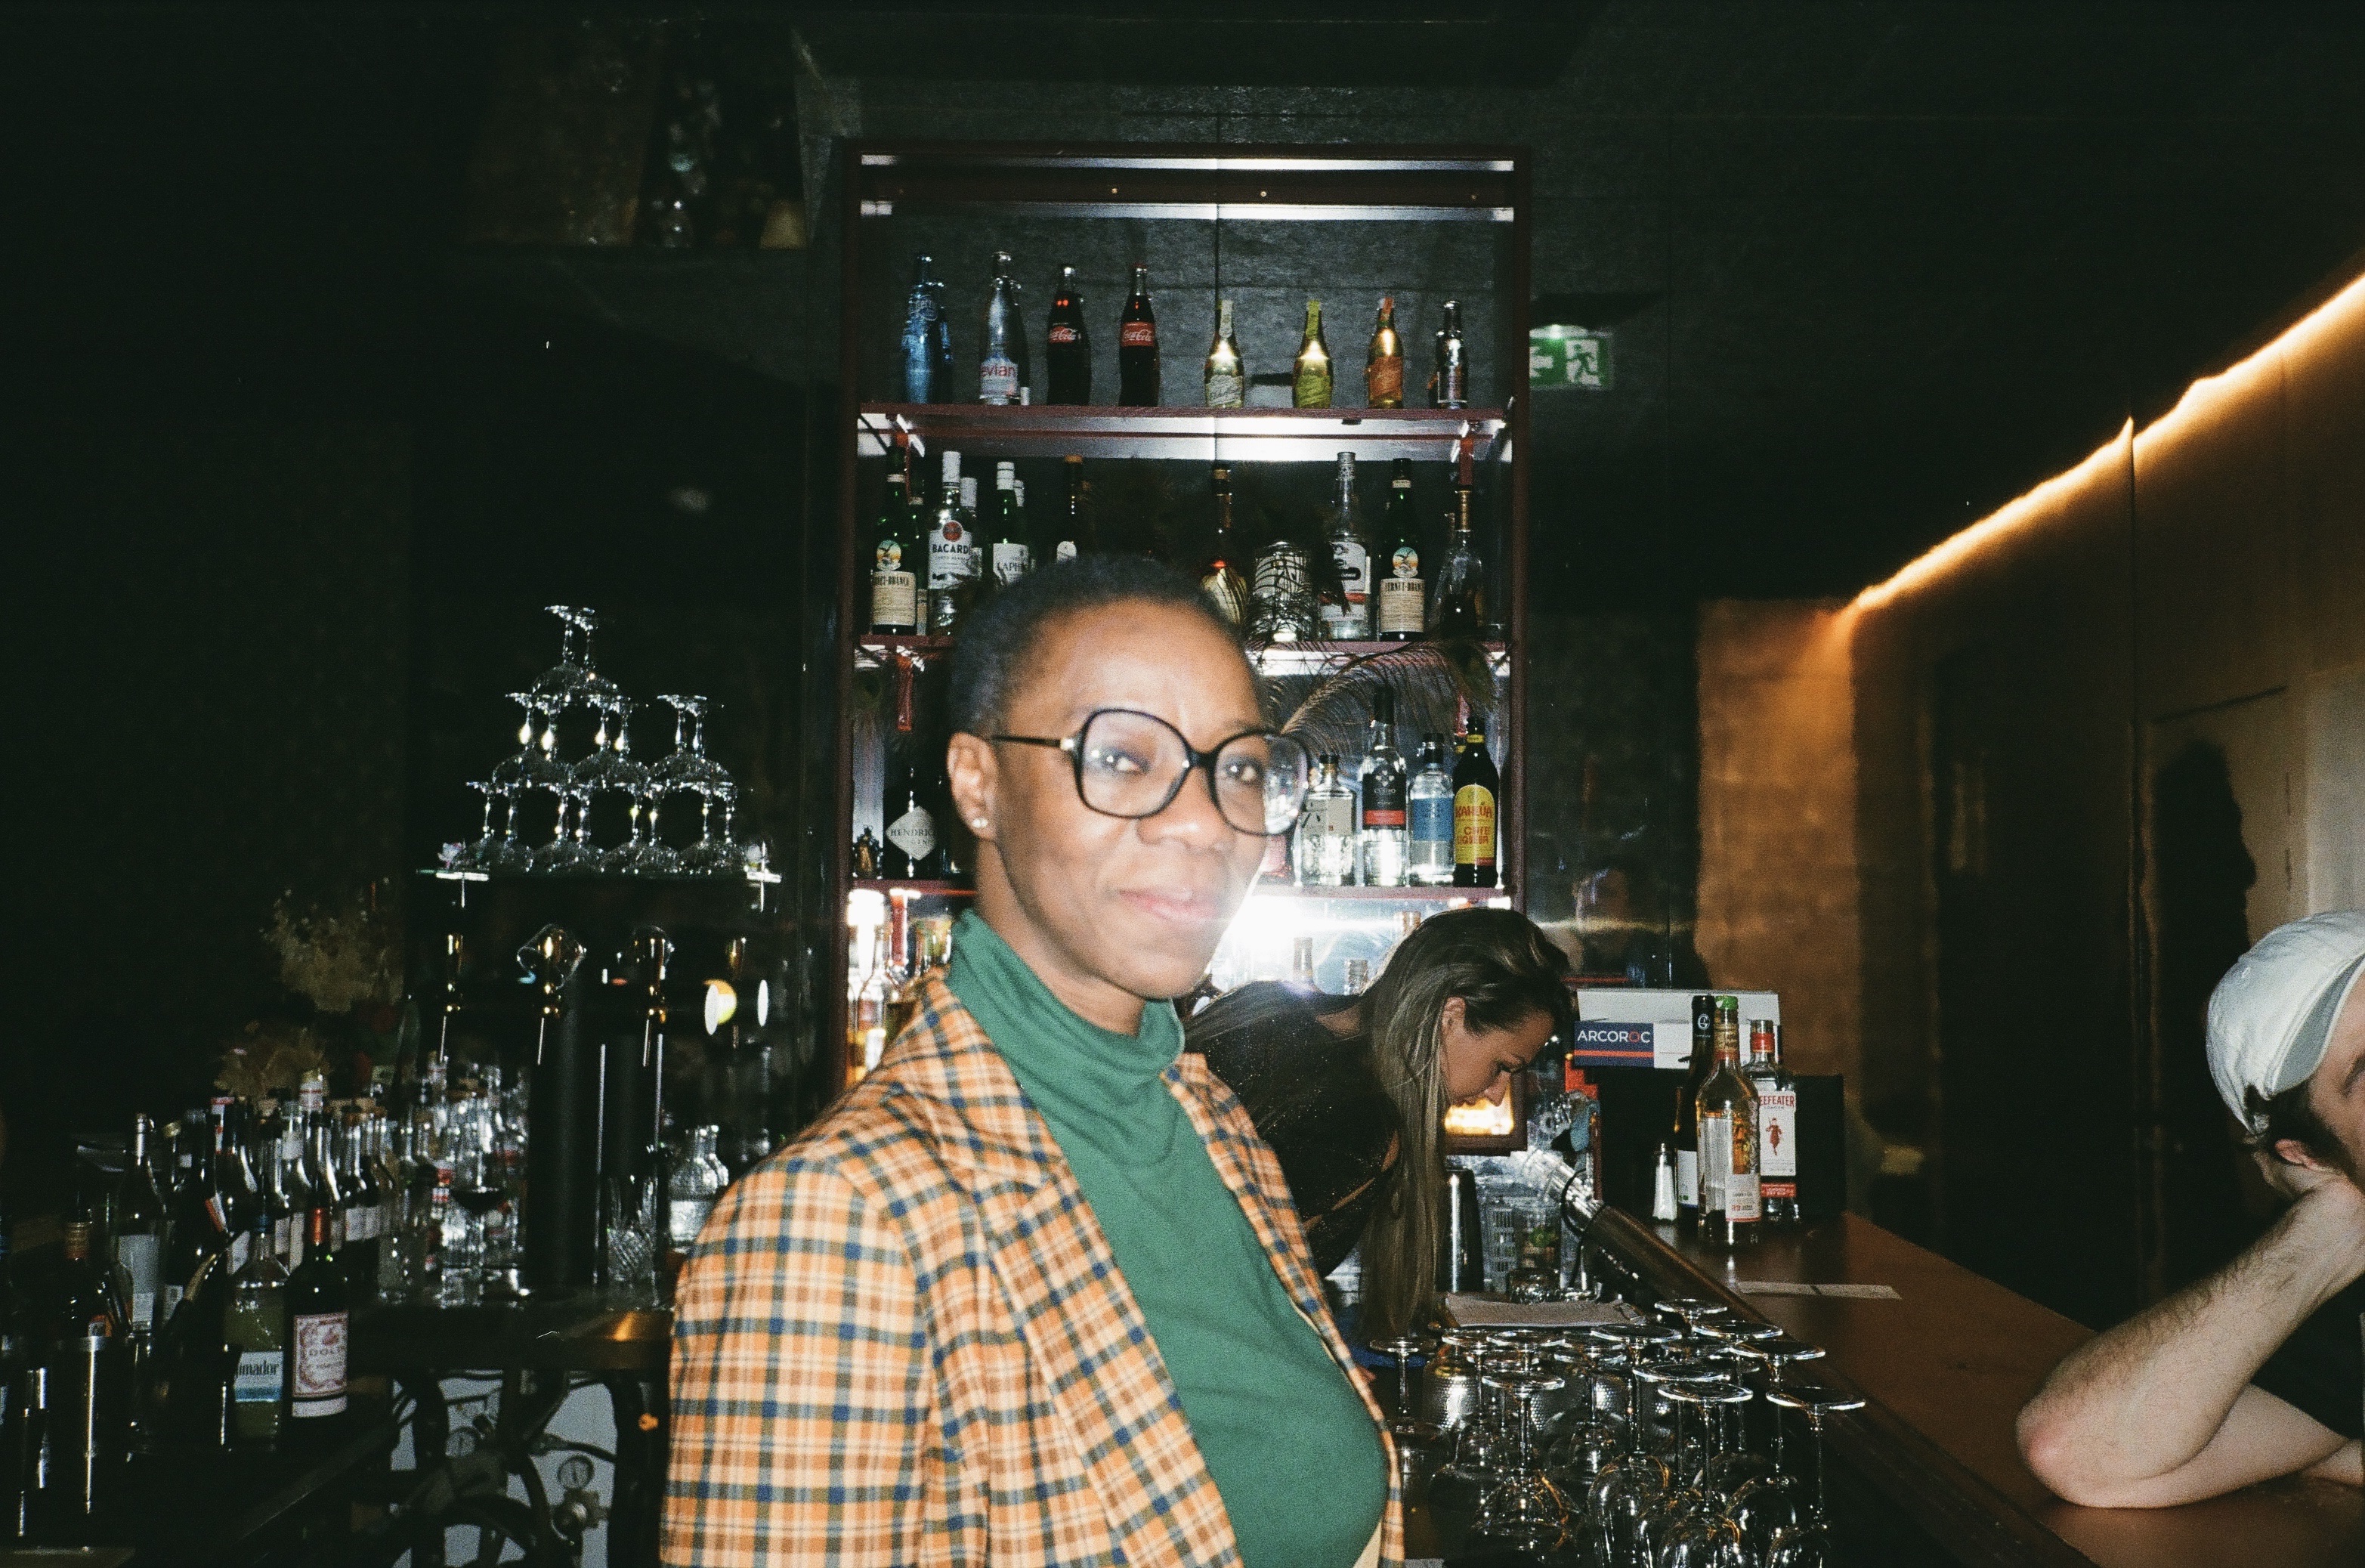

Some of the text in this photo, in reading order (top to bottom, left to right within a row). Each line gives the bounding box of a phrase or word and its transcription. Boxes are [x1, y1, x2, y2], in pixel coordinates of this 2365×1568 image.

[981, 365, 1016, 377] evian
[890, 828, 934, 837] HENDRIC
[1577, 1029, 1650, 1044] ARCOROC
[1759, 1095, 1795, 1109] EEFEATER
[237, 1360, 280, 1377] imador
